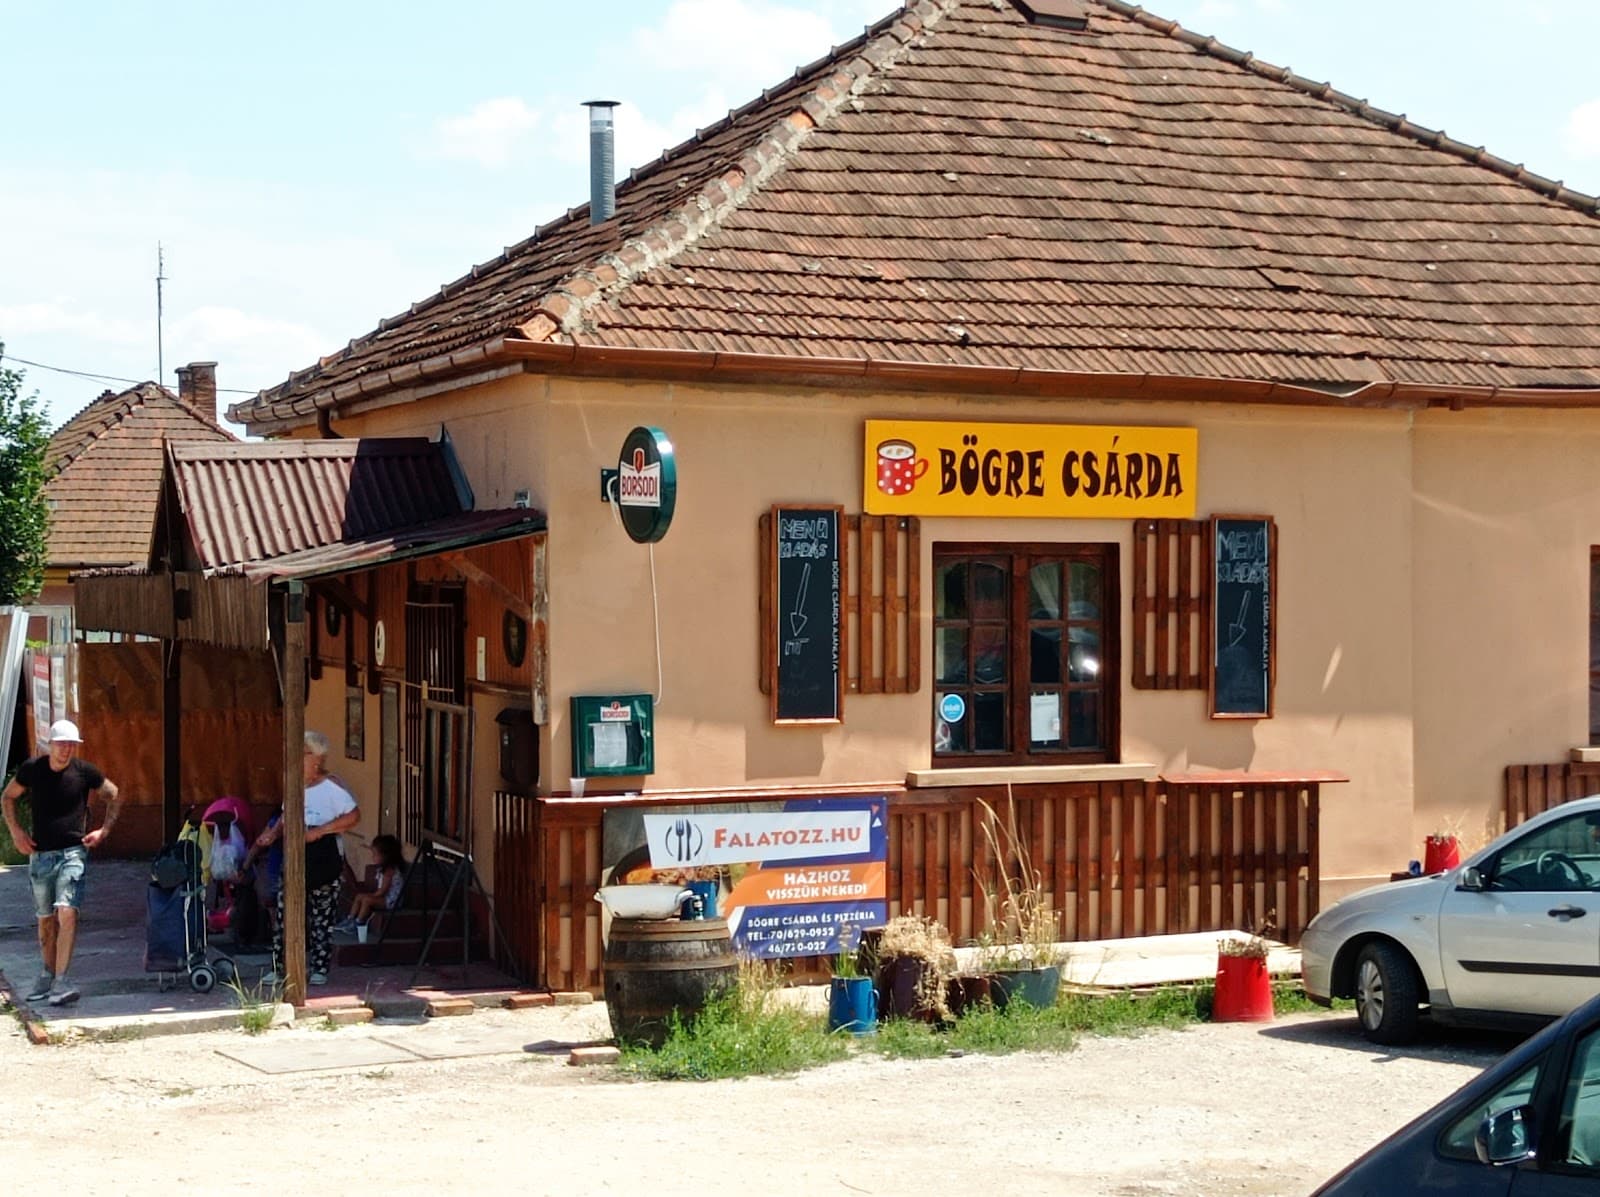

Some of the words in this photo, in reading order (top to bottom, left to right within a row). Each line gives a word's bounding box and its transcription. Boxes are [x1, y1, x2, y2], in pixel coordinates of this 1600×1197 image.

[938, 434, 1044, 498] BÖGRE
[1061, 435, 1184, 500] CSÁRDA
[622, 475, 658, 498] BORSODI
[714, 826, 862, 849] FALATOZZ.HU
[784, 869, 851, 885] HÁZHOZ
[766, 886, 820, 900] VISSZÜK
[822, 884, 867, 897] NEKED!
[748, 916, 779, 928] BÖGRE
[782, 914, 819, 926] CSÁRDA
[821, 912, 832, 923] ÉS
[834, 911, 875, 923] PIZZÉRIA
